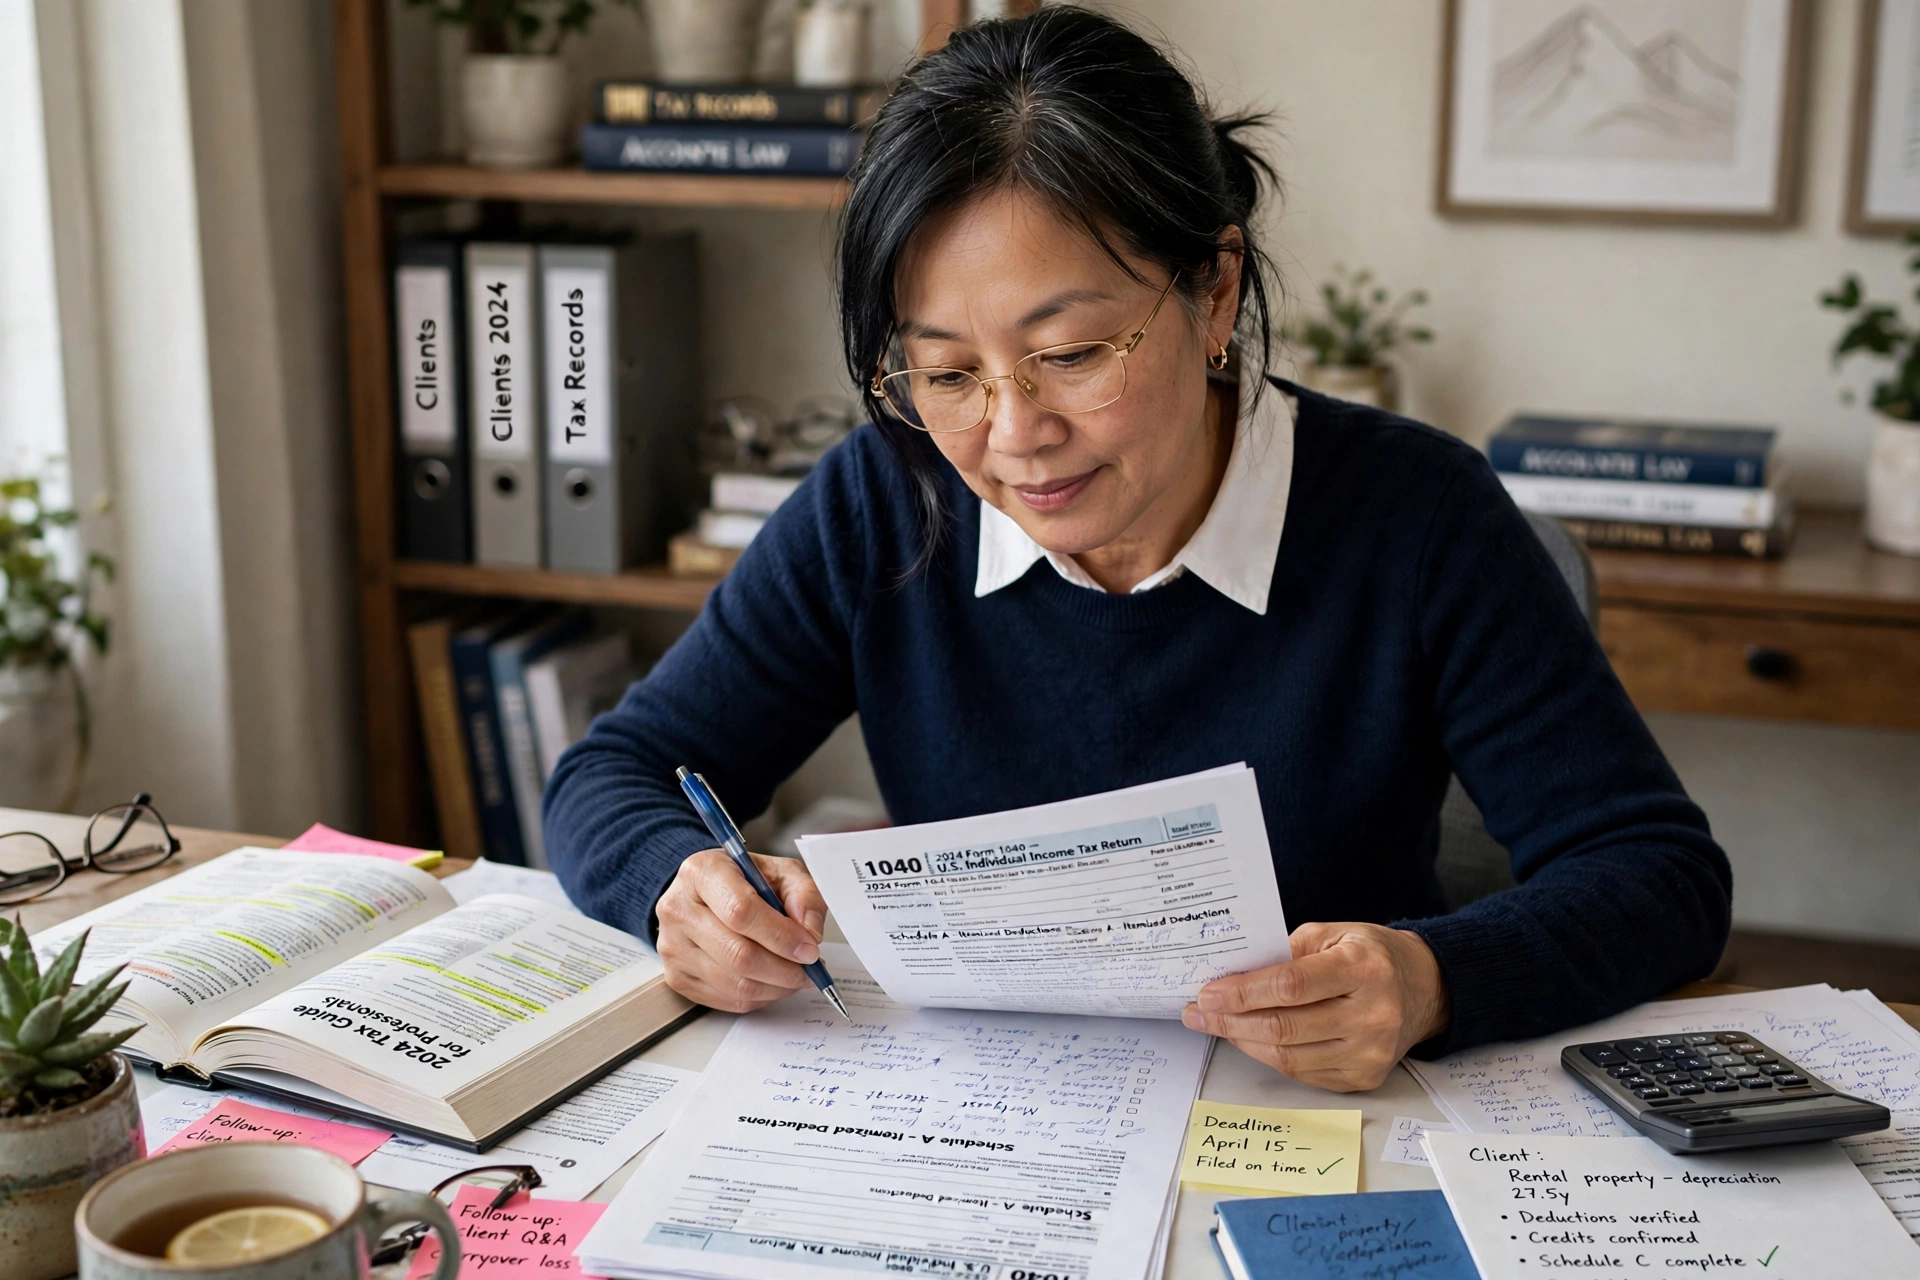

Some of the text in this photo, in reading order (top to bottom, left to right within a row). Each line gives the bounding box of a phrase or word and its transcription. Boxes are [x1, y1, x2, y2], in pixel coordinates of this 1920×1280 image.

[415, 319, 438, 410] Clients
[486, 281, 513, 441] Clients 2024
[561, 288, 588, 444] Tax Records
[937, 862, 963, 874] U.S.
[965, 854, 1027, 871] Individual
[1029, 848, 1075, 861] Income
[1076, 843, 1099, 854] Tax
[1100, 836, 1142, 851] Return
[999, 843, 1026, 855] 1040
[864, 857, 923, 877] 1040
[322, 996, 472, 1058] for Professionals
[293, 1004, 451, 1070] 2024 Tax Guide
[210, 1113, 302, 1141] Follow-up:
[737, 1115, 829, 1133] Deductions
[834, 1125, 904, 1142] Itemized
[1203, 1115, 1292, 1134] Deadline:
[920, 1133, 936, 1145] A
[939, 1136, 1016, 1153] Schedule
[1201, 1134, 1248, 1151] April
[1265, 1140, 1288, 1152] 15
[1196, 1155, 1308, 1175] Filed on time
[1509, 1168, 1568, 1184] Rental
[1583, 1171, 1655, 1189] property
[1682, 1171, 1781, 1188] depreciation
[1004, 1201, 1016, 1211] A
[1511, 1187, 1570, 1206] 27.5y
[459, 1204, 562, 1231] Follow-up:
[1021, 1203, 1093, 1222] Schedule
[1518, 1210, 1701, 1224] Deductions verified
[521, 1230, 567, 1246] Q&A
[1529, 1231, 1700, 1245] Credits confirmed
[539, 1254, 572, 1270] loss
[1539, 1254, 1747, 1271] Schedule C complete
